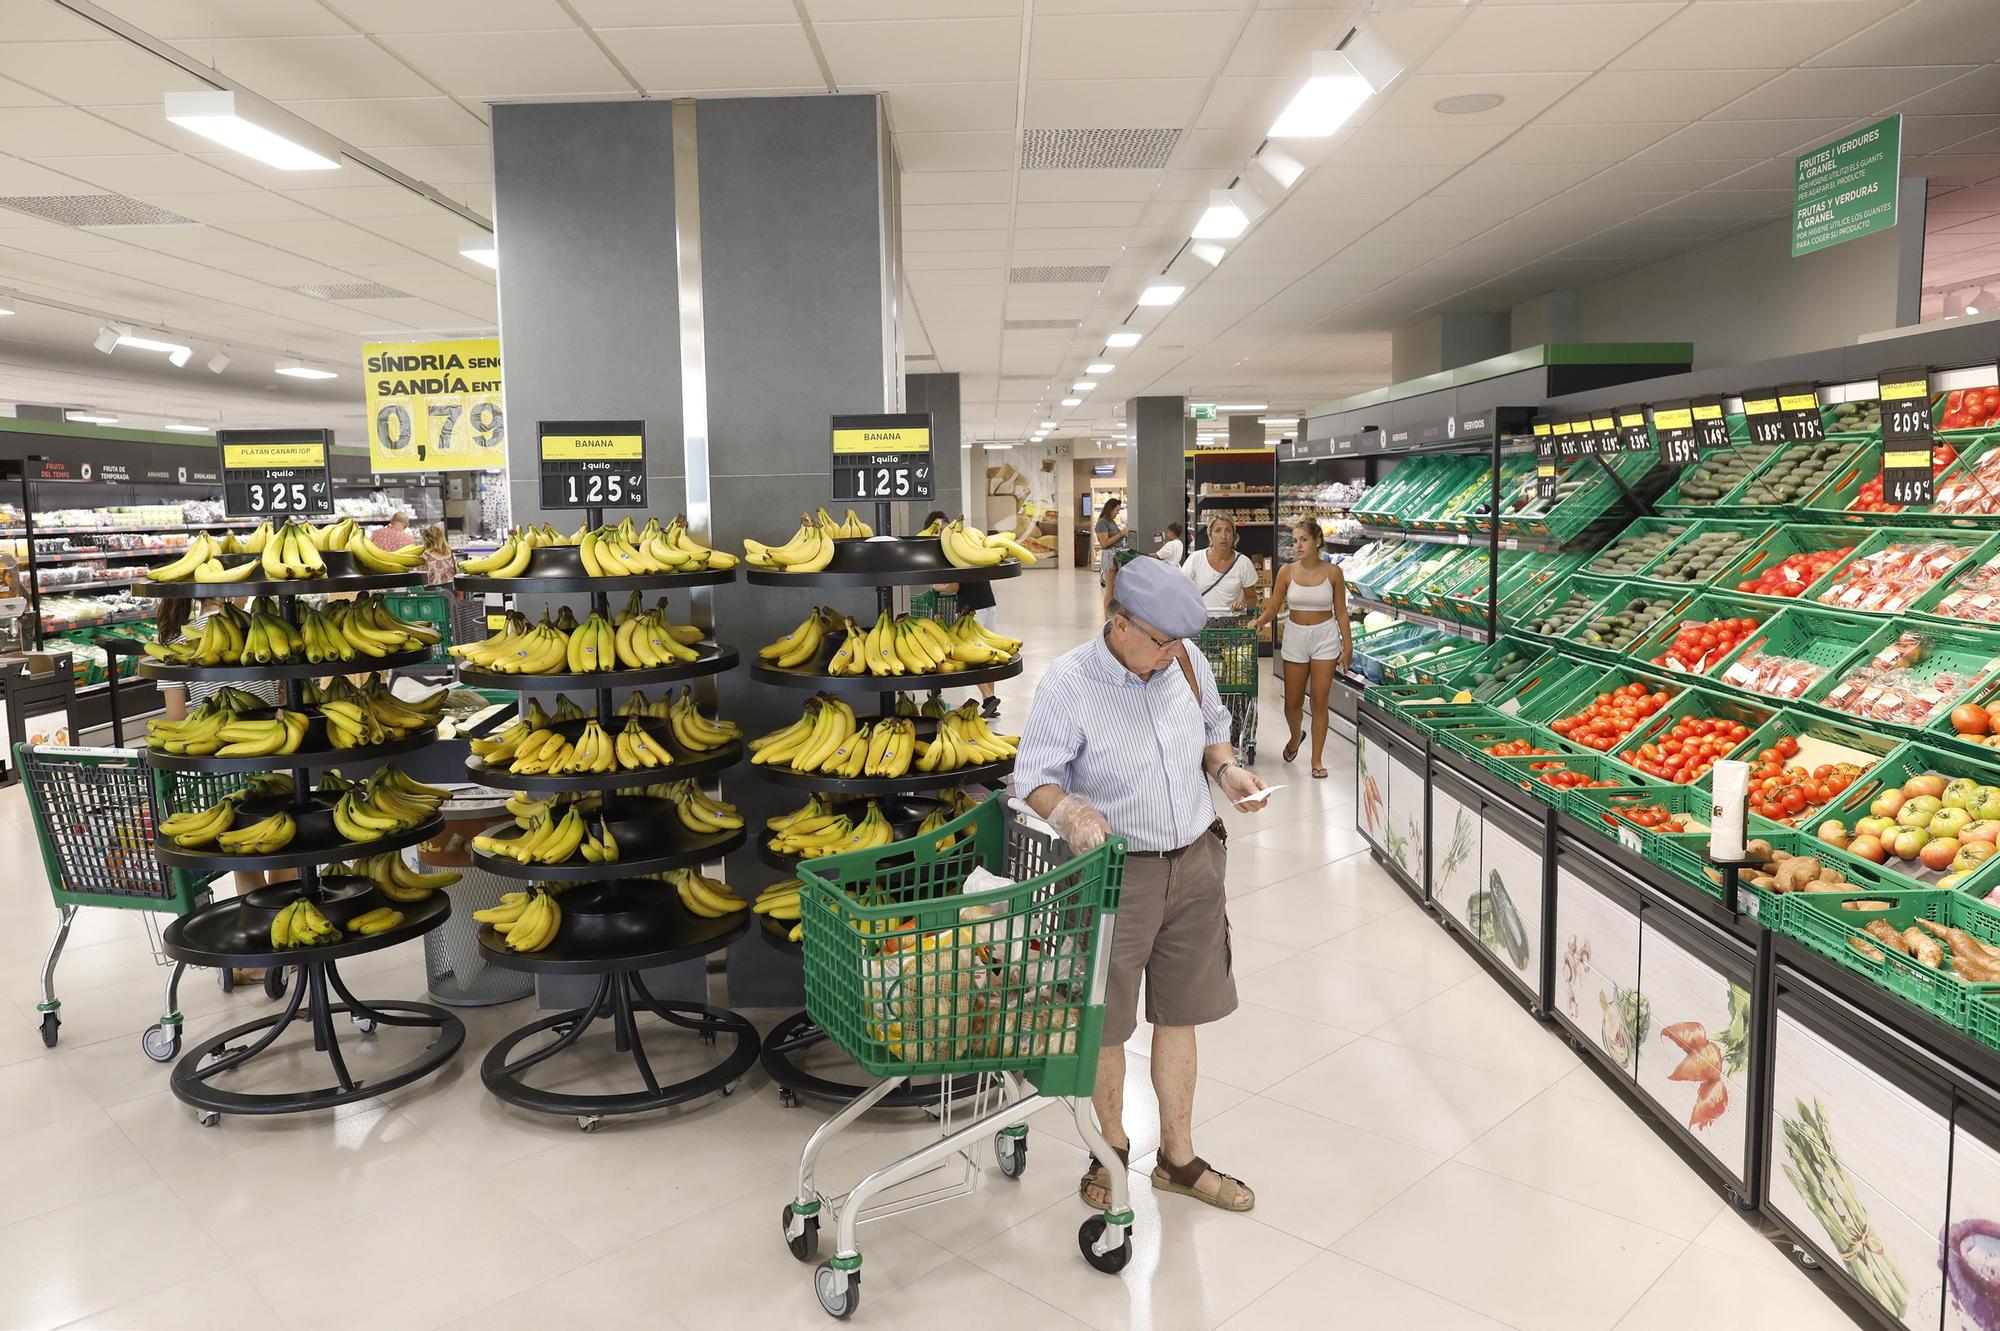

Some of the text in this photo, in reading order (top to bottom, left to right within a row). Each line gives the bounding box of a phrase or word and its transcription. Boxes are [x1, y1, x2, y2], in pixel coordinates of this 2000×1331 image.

[1800, 129, 1880, 170] FRUITES I VERDURES
[1798, 182, 1808, 191] PER
[1808, 174, 1828, 186] HIGIENE
[1850, 162, 1860, 172] ELS
[1860, 152, 1884, 167] GUANTS
[1799, 160, 1837, 182] A GRANEL
[1798, 192, 1808, 200] PER
[1808, 184, 1829, 196] AGAFAR
[1836, 169, 1866, 186] PRODUCTE
[1798, 182, 1878, 220] FRUTAS Y VERDURAS
[1796, 210, 1834, 230] A GRANEL
[1796, 202, 1892, 240] POR HIGIENE UTILICE LOS GUANTES
[1796, 220, 1870, 248] PARA COGER SU PRODUCTO
[368, 352, 500, 373] SÍNDRIA SEN
[378, 373, 469, 396] SANDÍA
[377, 402, 504, 461] 0,79
[1464, 419, 1484, 430] HERVIDOS
[588, 462, 610, 470] quilo
[876, 456, 898, 464] quilo
[272, 470, 294, 478] quilo
[631, 493, 640, 502] kg
[918, 486, 928, 494] kg
[318, 500, 328, 509] kg
